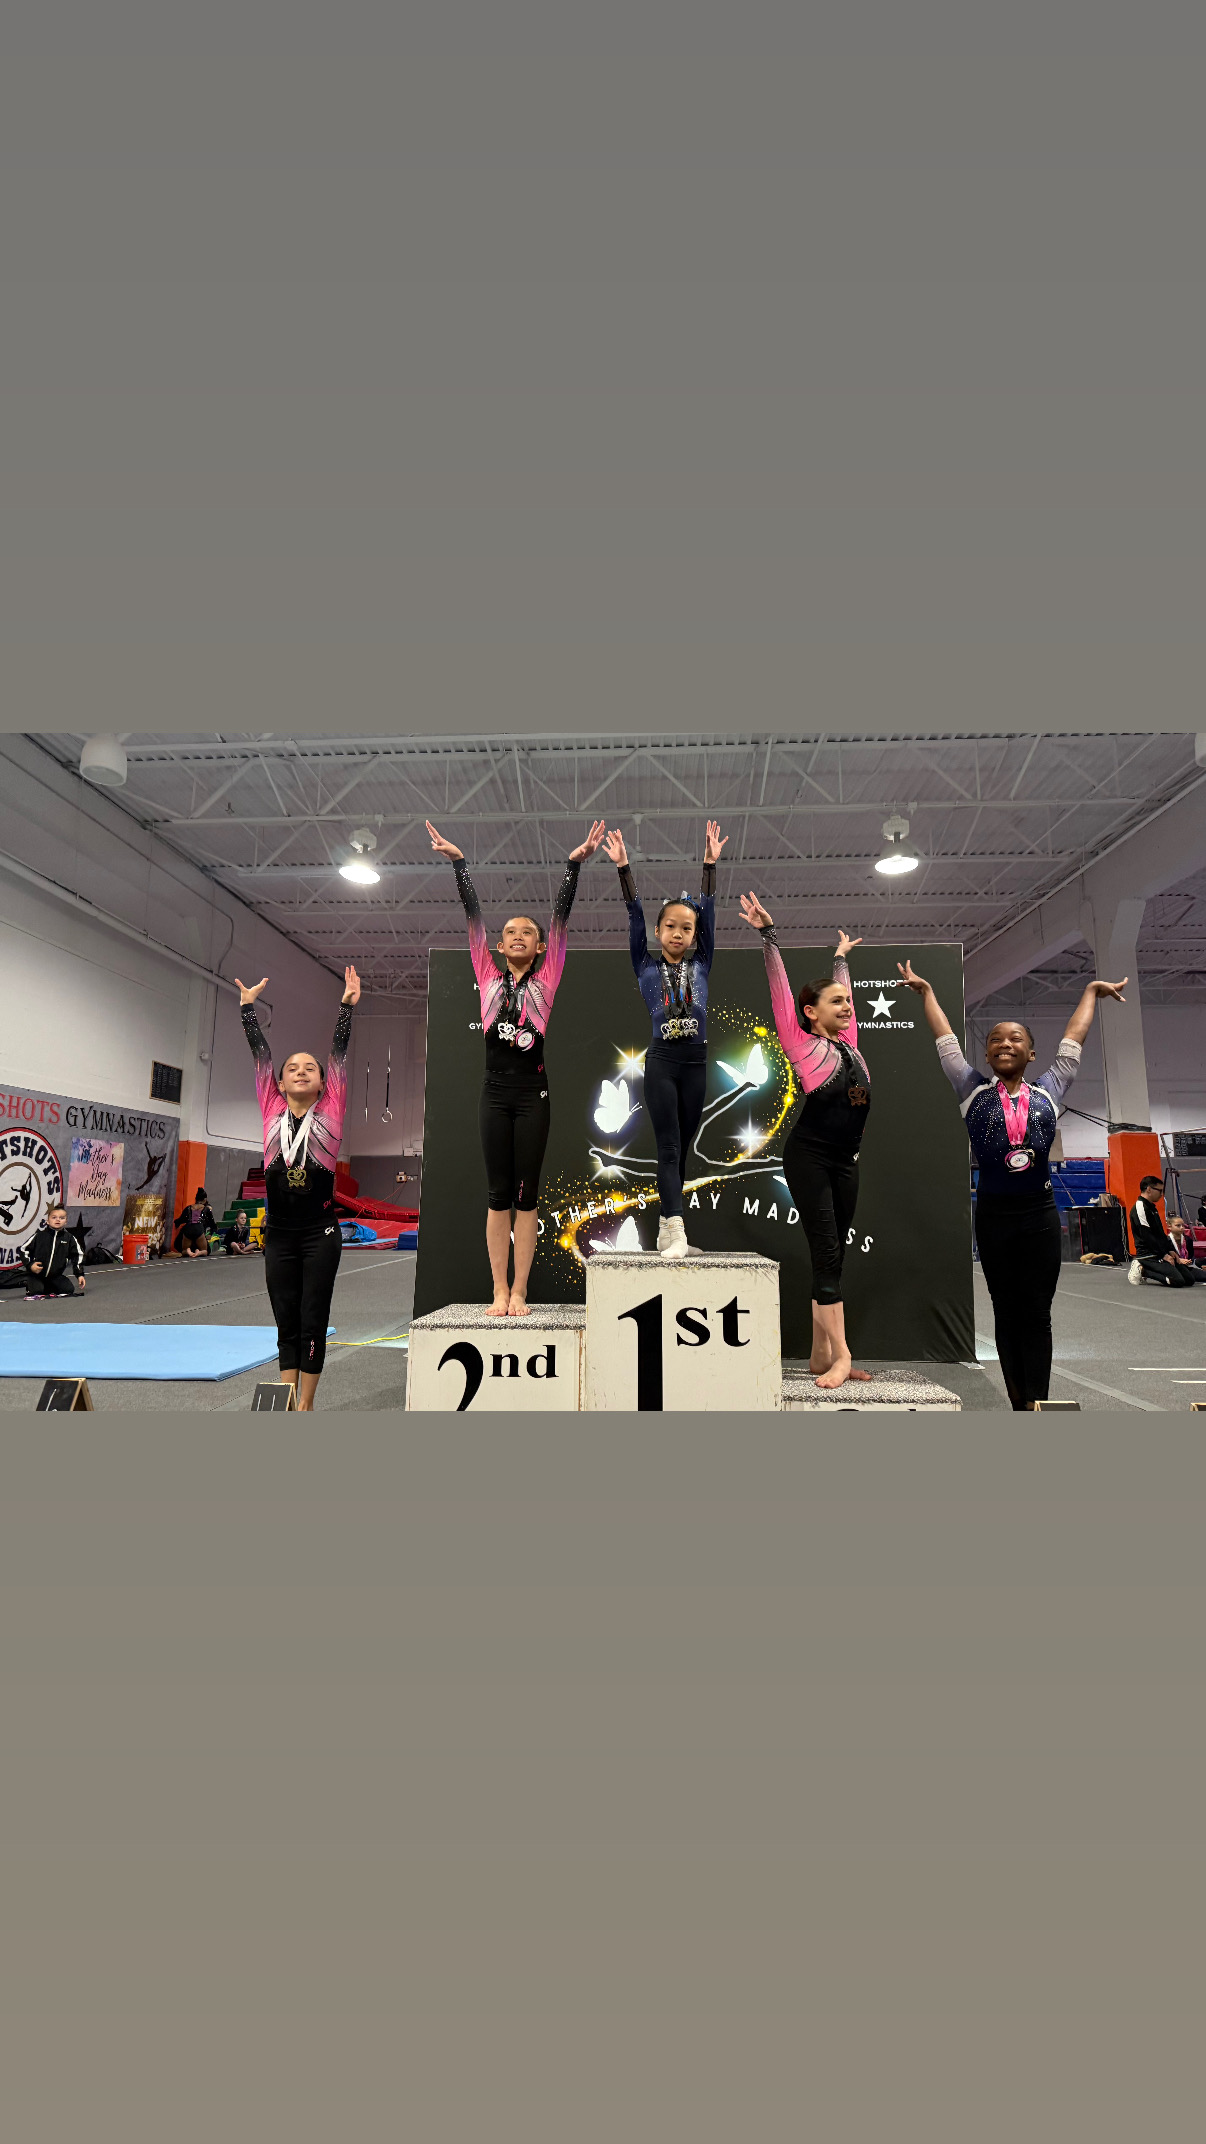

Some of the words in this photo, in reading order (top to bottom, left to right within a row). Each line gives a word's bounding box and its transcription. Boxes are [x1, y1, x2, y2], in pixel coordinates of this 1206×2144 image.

[857, 1021, 914, 1029] YMNASTICS
[65, 1105, 166, 1140] GYMNASTICS
[134, 1216, 158, 1229] NEW
[511, 1193, 647, 1244] OTHER'S
[689, 1192, 720, 1209] AY
[743, 1197, 873, 1252] MADSS
[437, 1341, 559, 1411] 2nd
[617, 1294, 750, 1411] 1st
